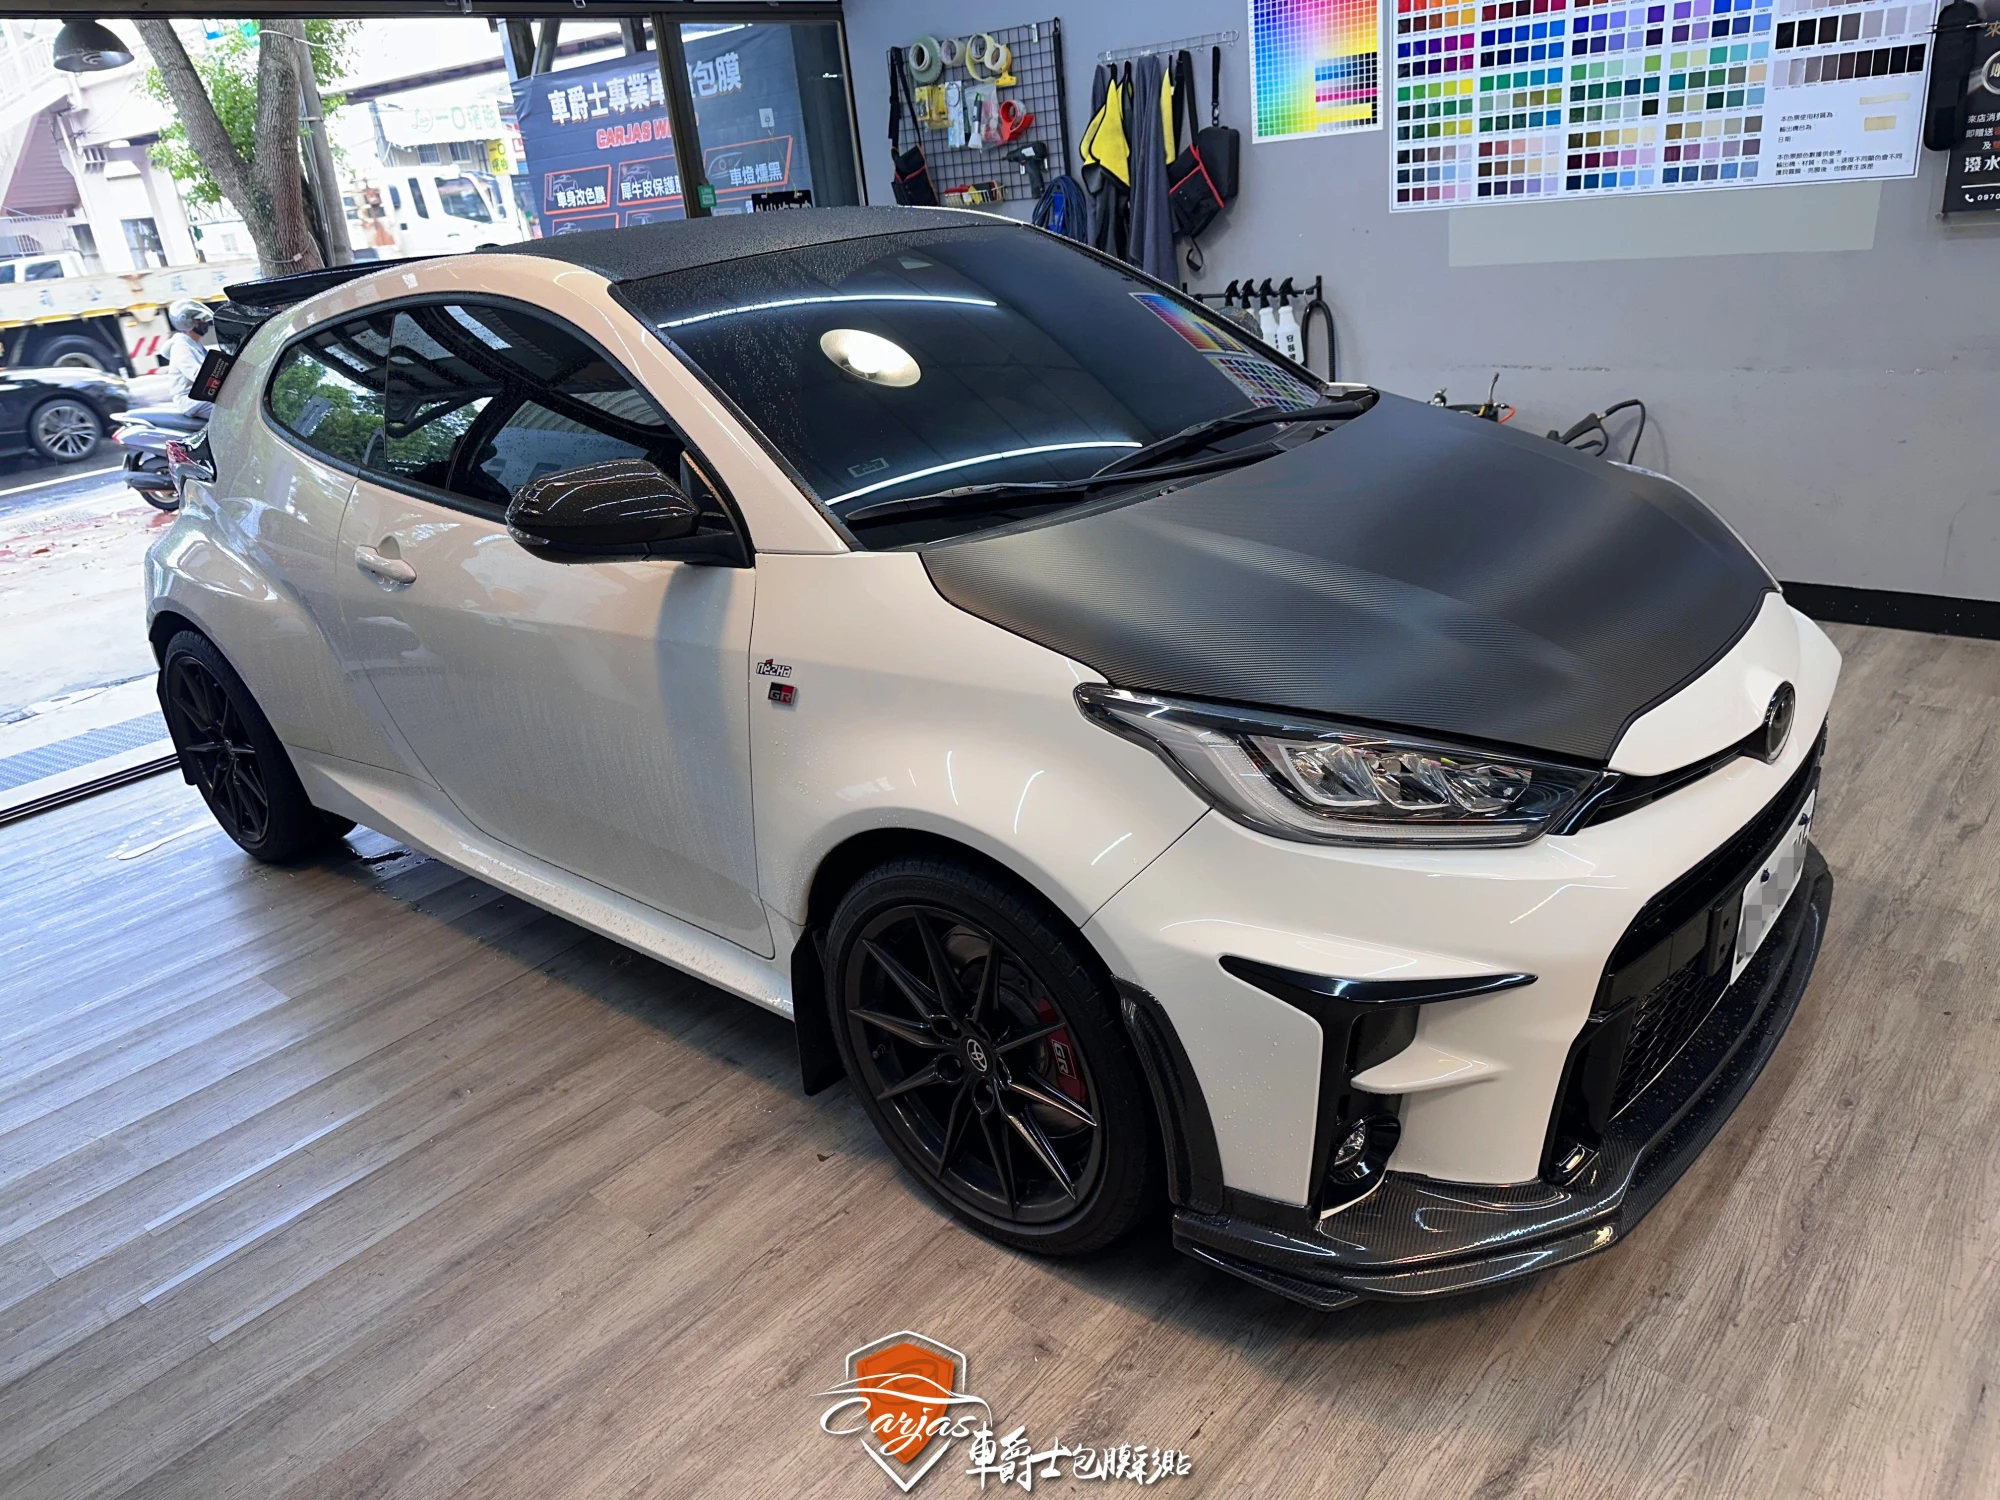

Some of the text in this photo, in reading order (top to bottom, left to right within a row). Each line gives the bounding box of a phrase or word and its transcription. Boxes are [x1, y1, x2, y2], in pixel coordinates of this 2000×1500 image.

[596, 120, 652, 149] CARJAS
[728, 161, 783, 187] 車燈燻黑
[556, 186, 607, 209] 車身改色膜
[1977, 193, 2000, 201] 0970
[207, 379, 221, 396] GR
[769, 689, 792, 702] GR
[1053, 1042, 1069, 1074] GR
